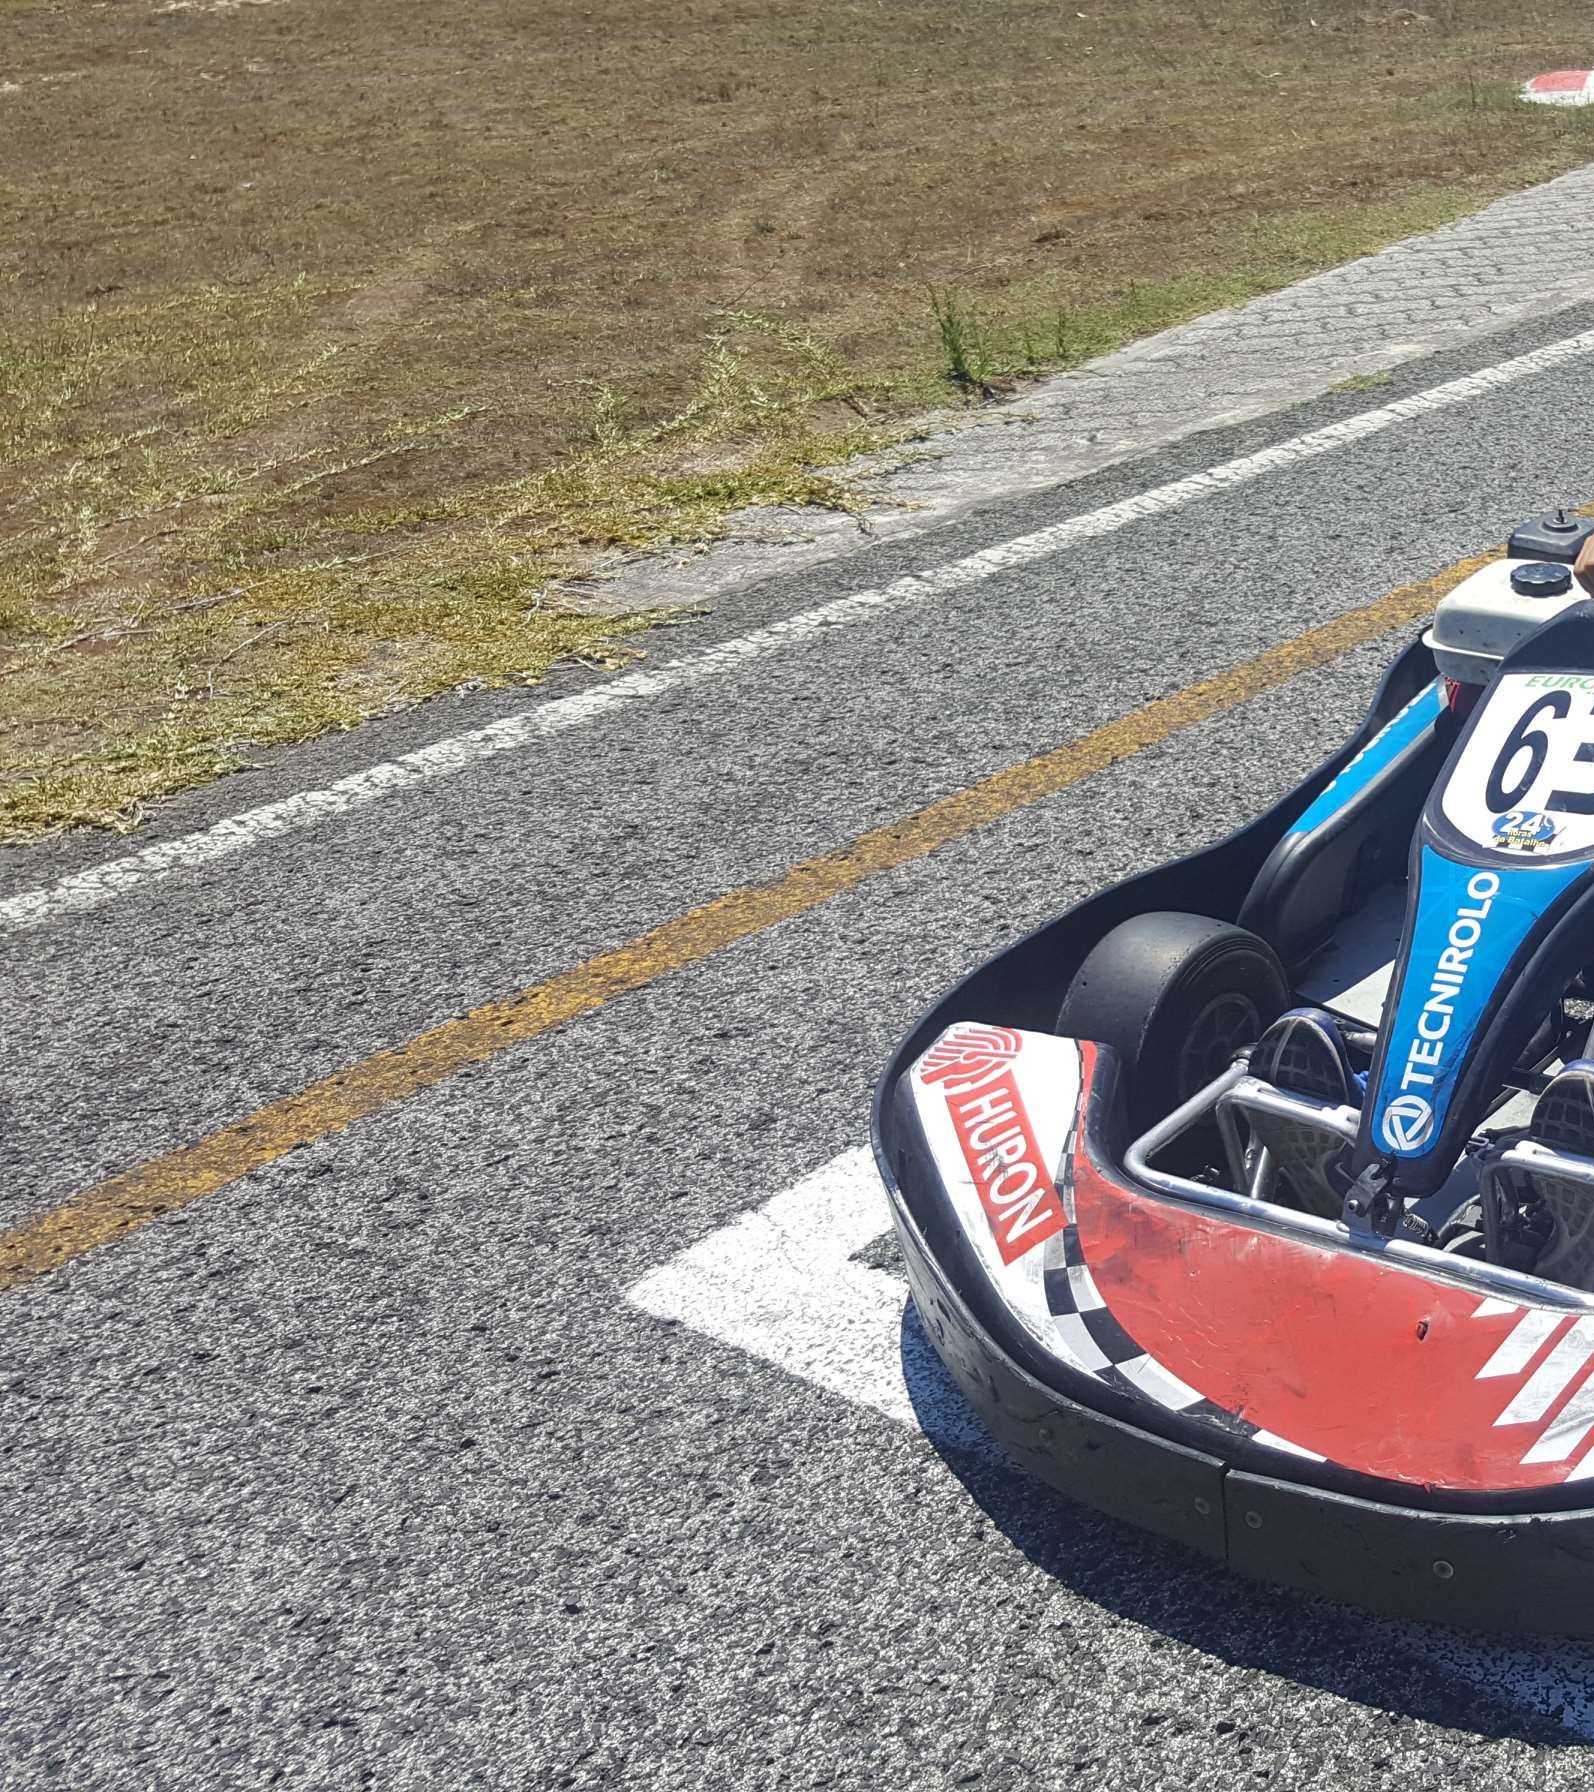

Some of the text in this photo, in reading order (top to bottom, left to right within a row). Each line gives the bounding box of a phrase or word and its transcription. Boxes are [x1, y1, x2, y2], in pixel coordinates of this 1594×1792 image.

[1500, 811, 1543, 834] 24
[1400, 871, 1500, 1090] TECNIROLO
[960, 1087, 1054, 1243] HURON
